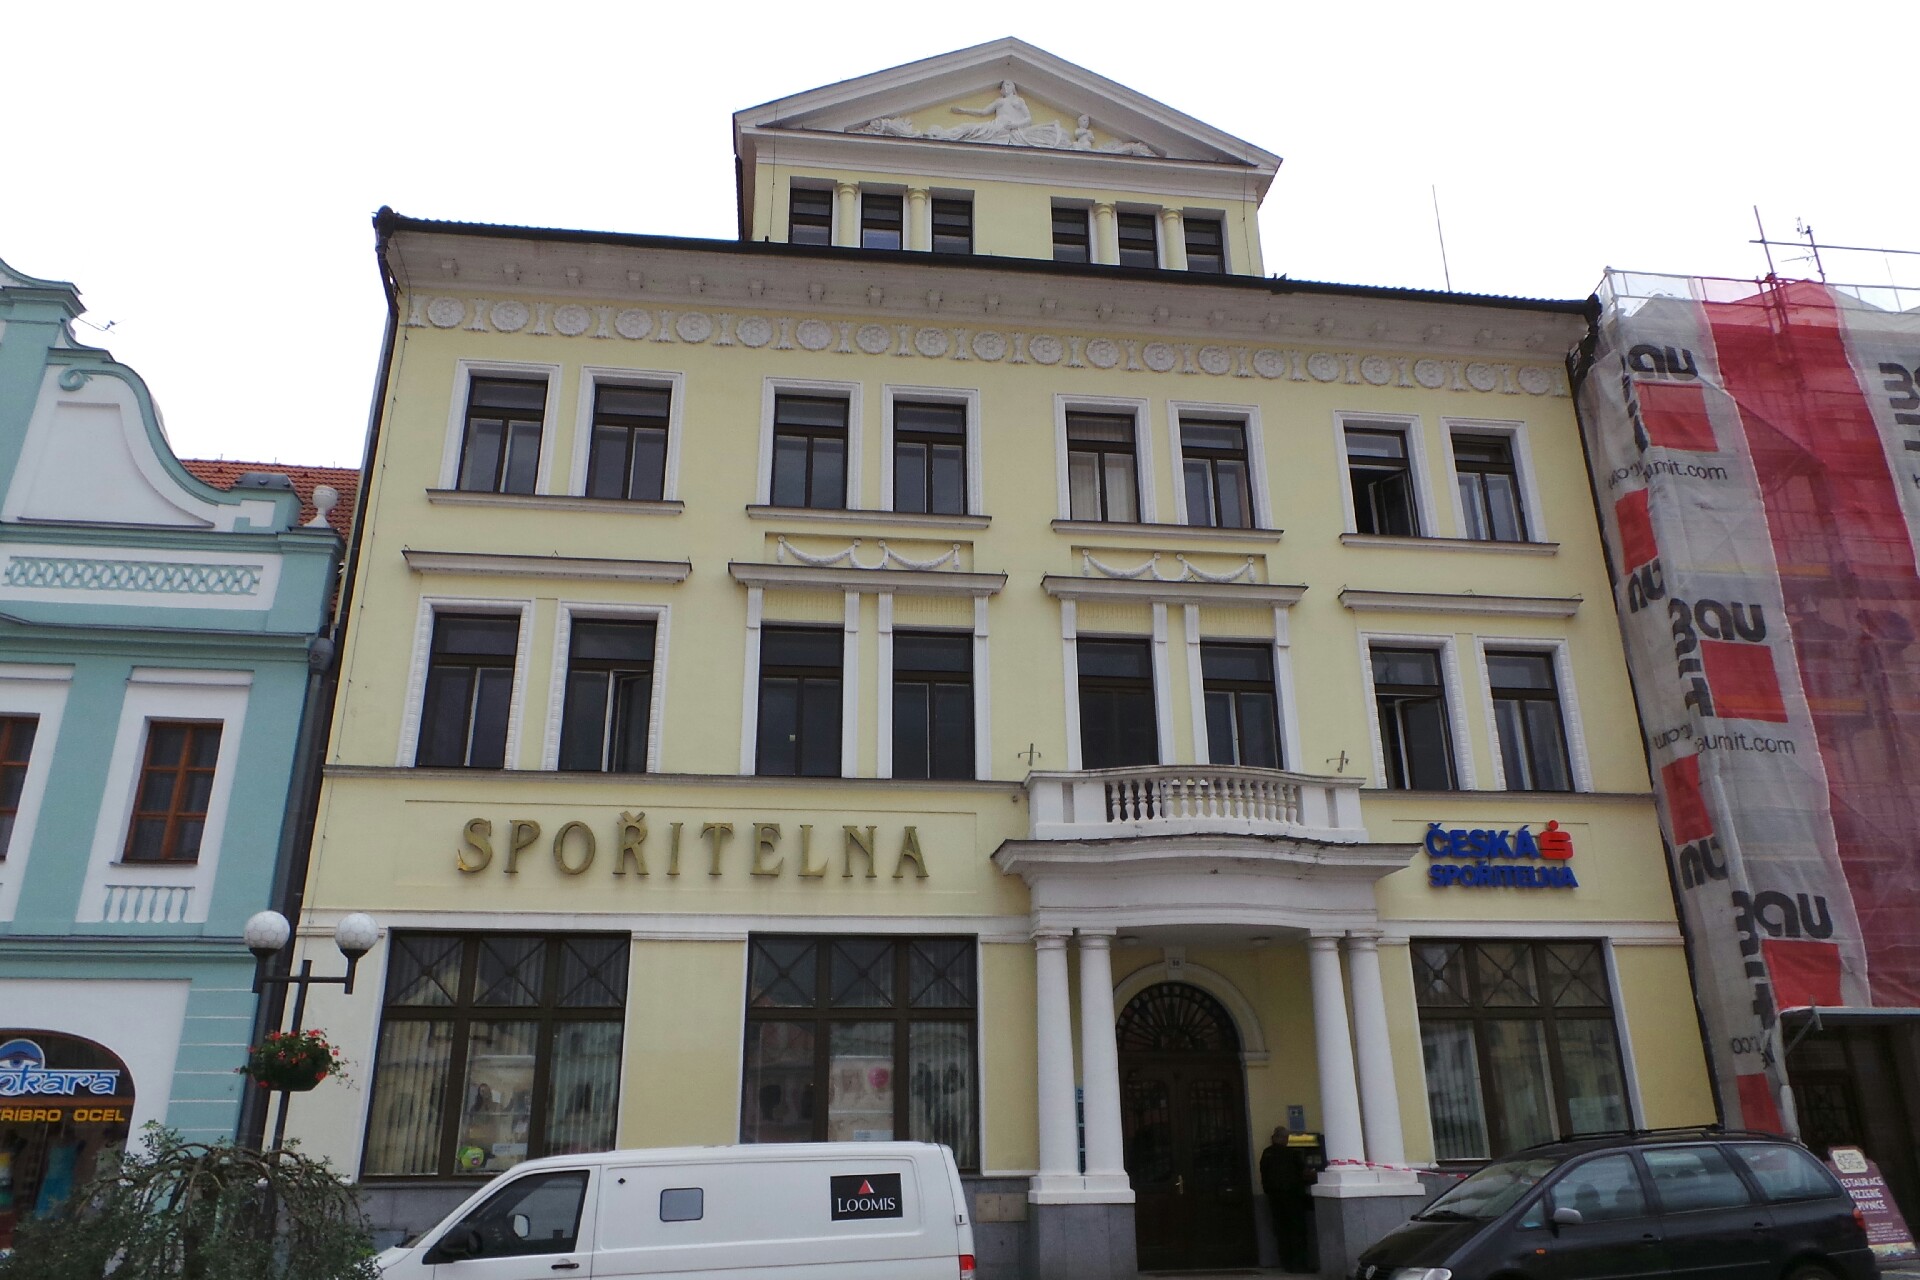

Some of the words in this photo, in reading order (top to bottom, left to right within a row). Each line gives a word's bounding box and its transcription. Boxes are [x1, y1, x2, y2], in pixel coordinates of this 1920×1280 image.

[457, 811, 930, 879] SPOŘITELNA
[1425, 822, 1541, 860] ČESKÁ
[1428, 860, 1579, 888] SPOŘITELNA
[72, 1109, 126, 1122] OCEL
[1840, 1176, 1884, 1188] ESTAURACE
[837, 1197, 897, 1214] LOOMIS
